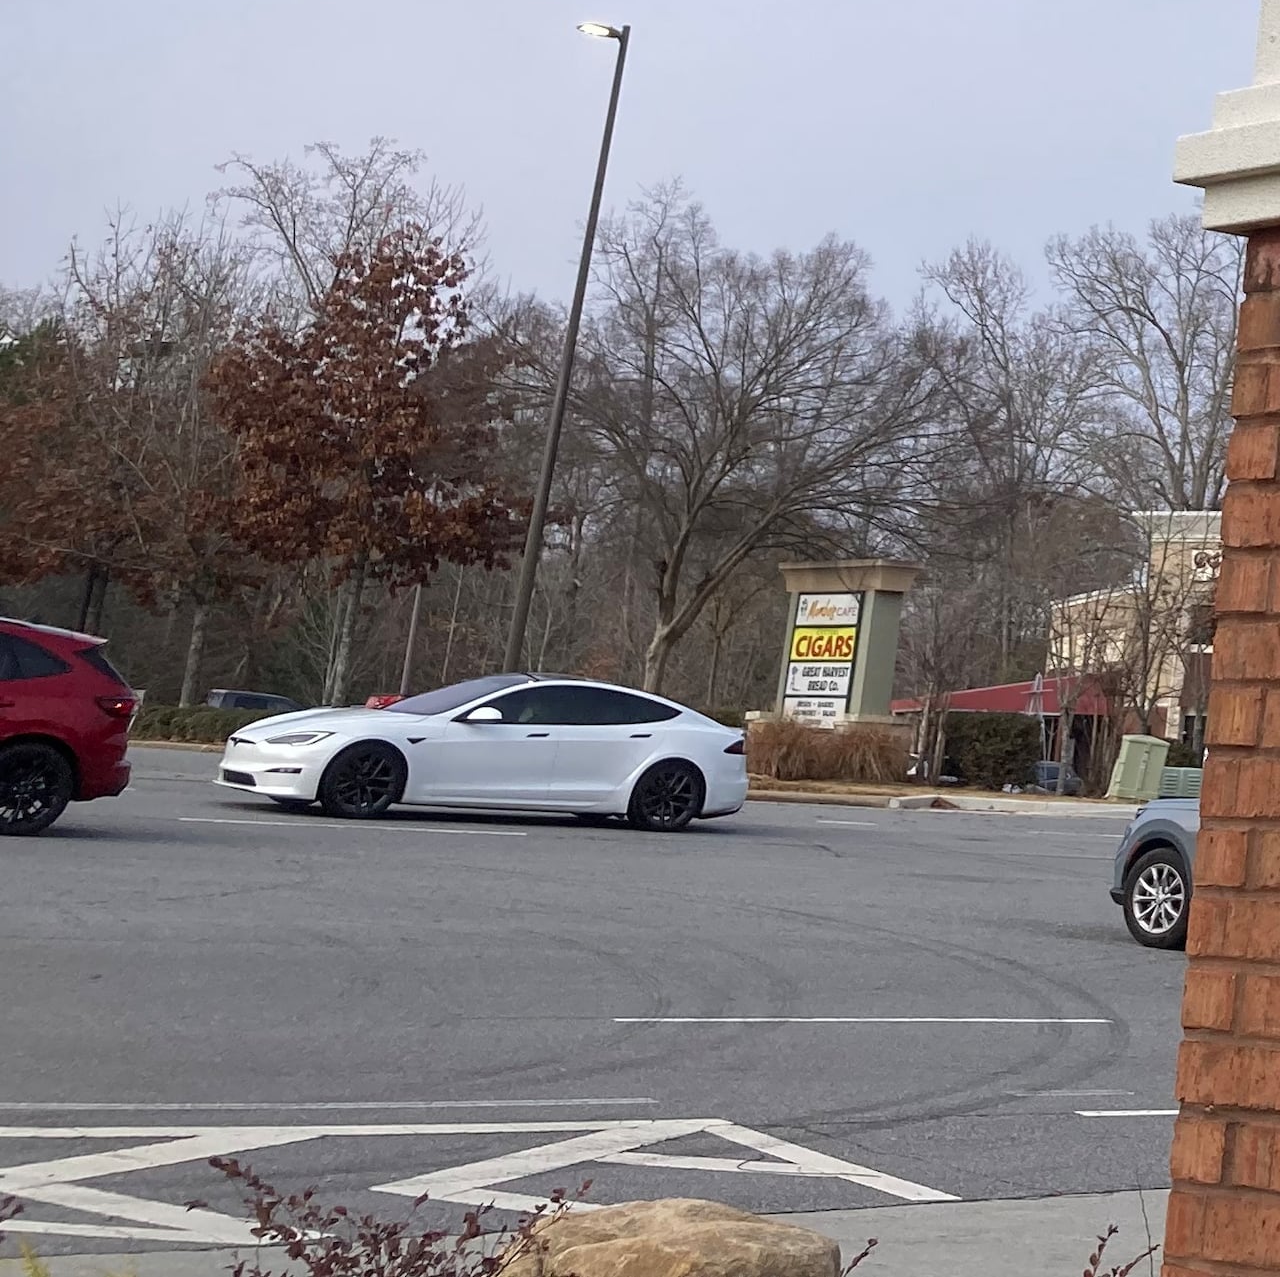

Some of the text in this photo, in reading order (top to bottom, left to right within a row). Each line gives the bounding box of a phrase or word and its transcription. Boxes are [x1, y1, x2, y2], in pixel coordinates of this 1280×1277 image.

[795, 635, 854, 658] CIGARS
[802, 666, 850, 678] GREAT HARVEST
[807, 680, 828, 692] BREAD
